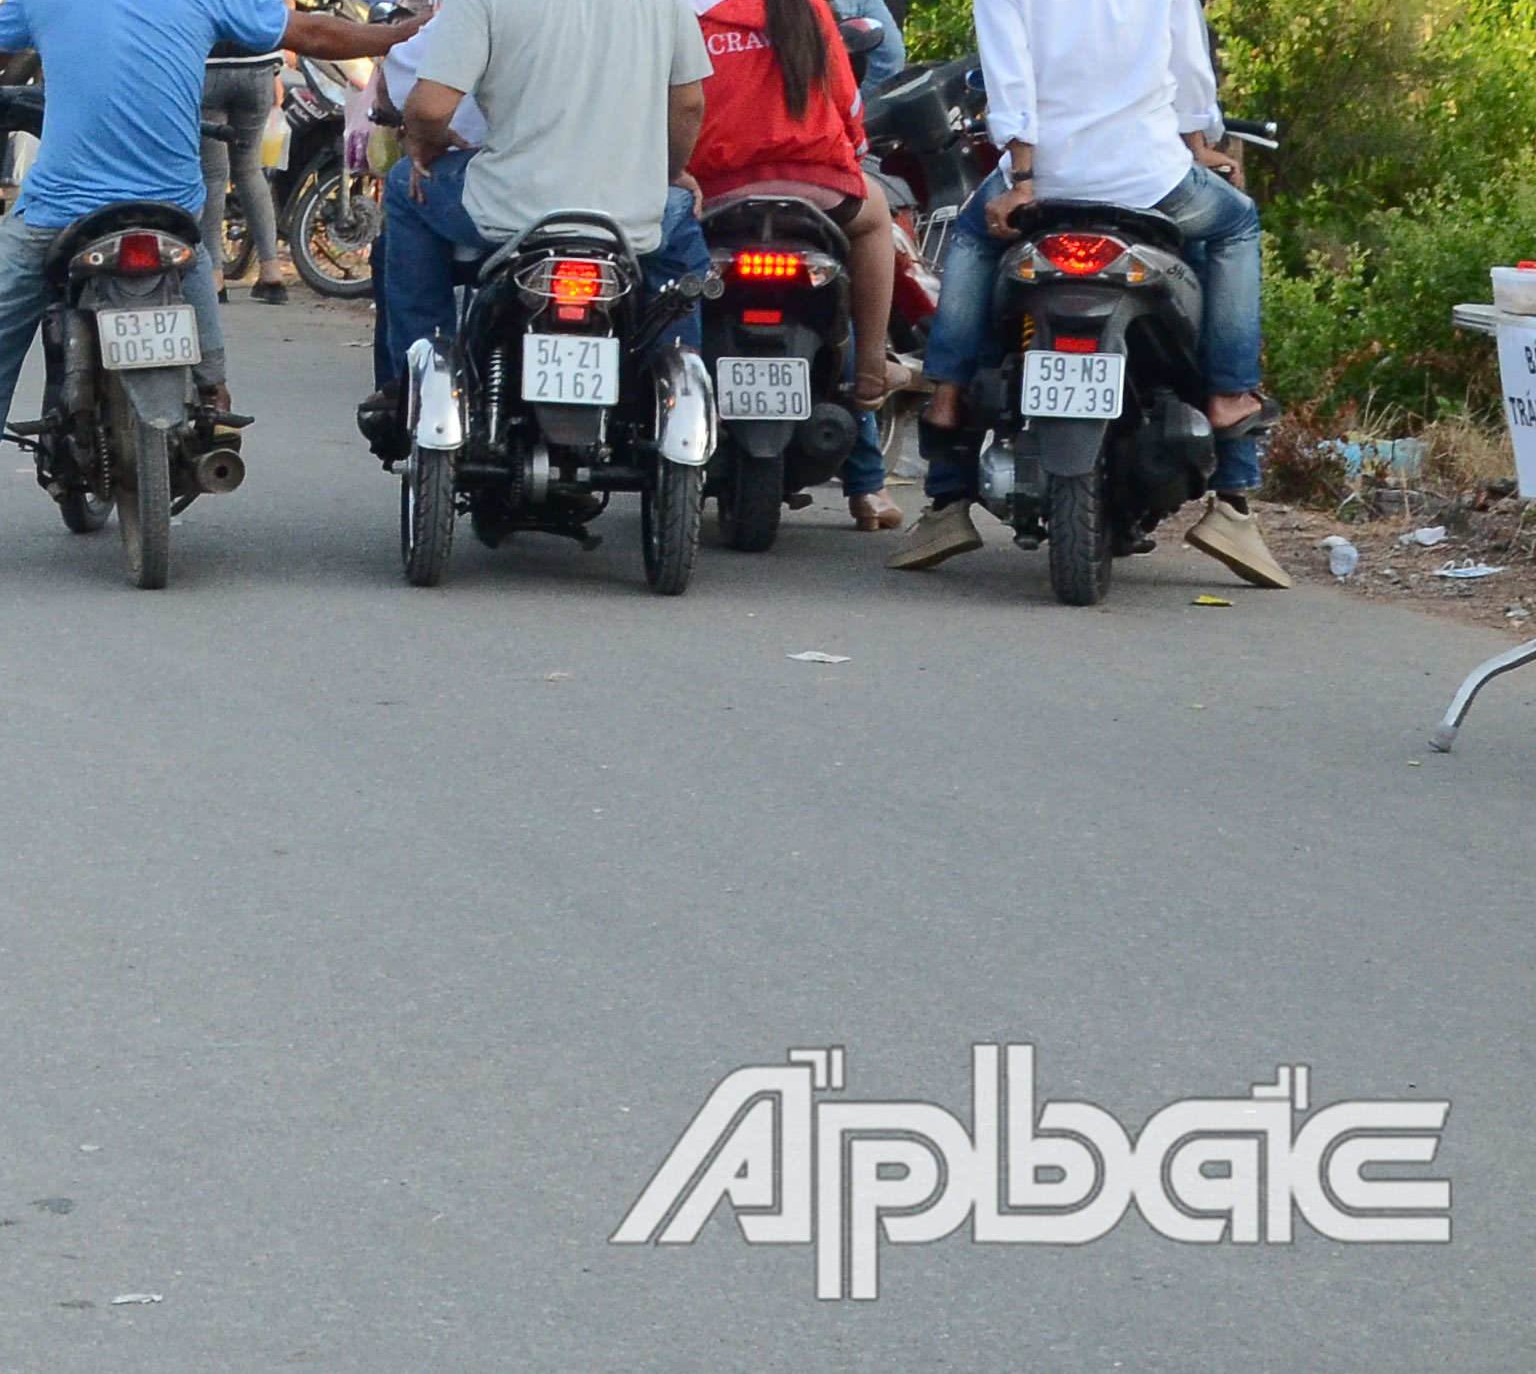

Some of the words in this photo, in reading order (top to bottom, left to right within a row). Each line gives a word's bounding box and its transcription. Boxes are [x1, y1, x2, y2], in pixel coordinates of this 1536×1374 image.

[114, 311, 178, 337] 63-B7
[108, 336, 192, 363] 005.98
[537, 338, 601, 369] 54-Z1
[732, 362, 794, 387] 63-B6
[1040, 356, 1108, 383] 59-N3
[536, 371, 604, 400] 2162
[1029, 385, 1115, 413] 397.39
[725, 390, 803, 415] 196.30
